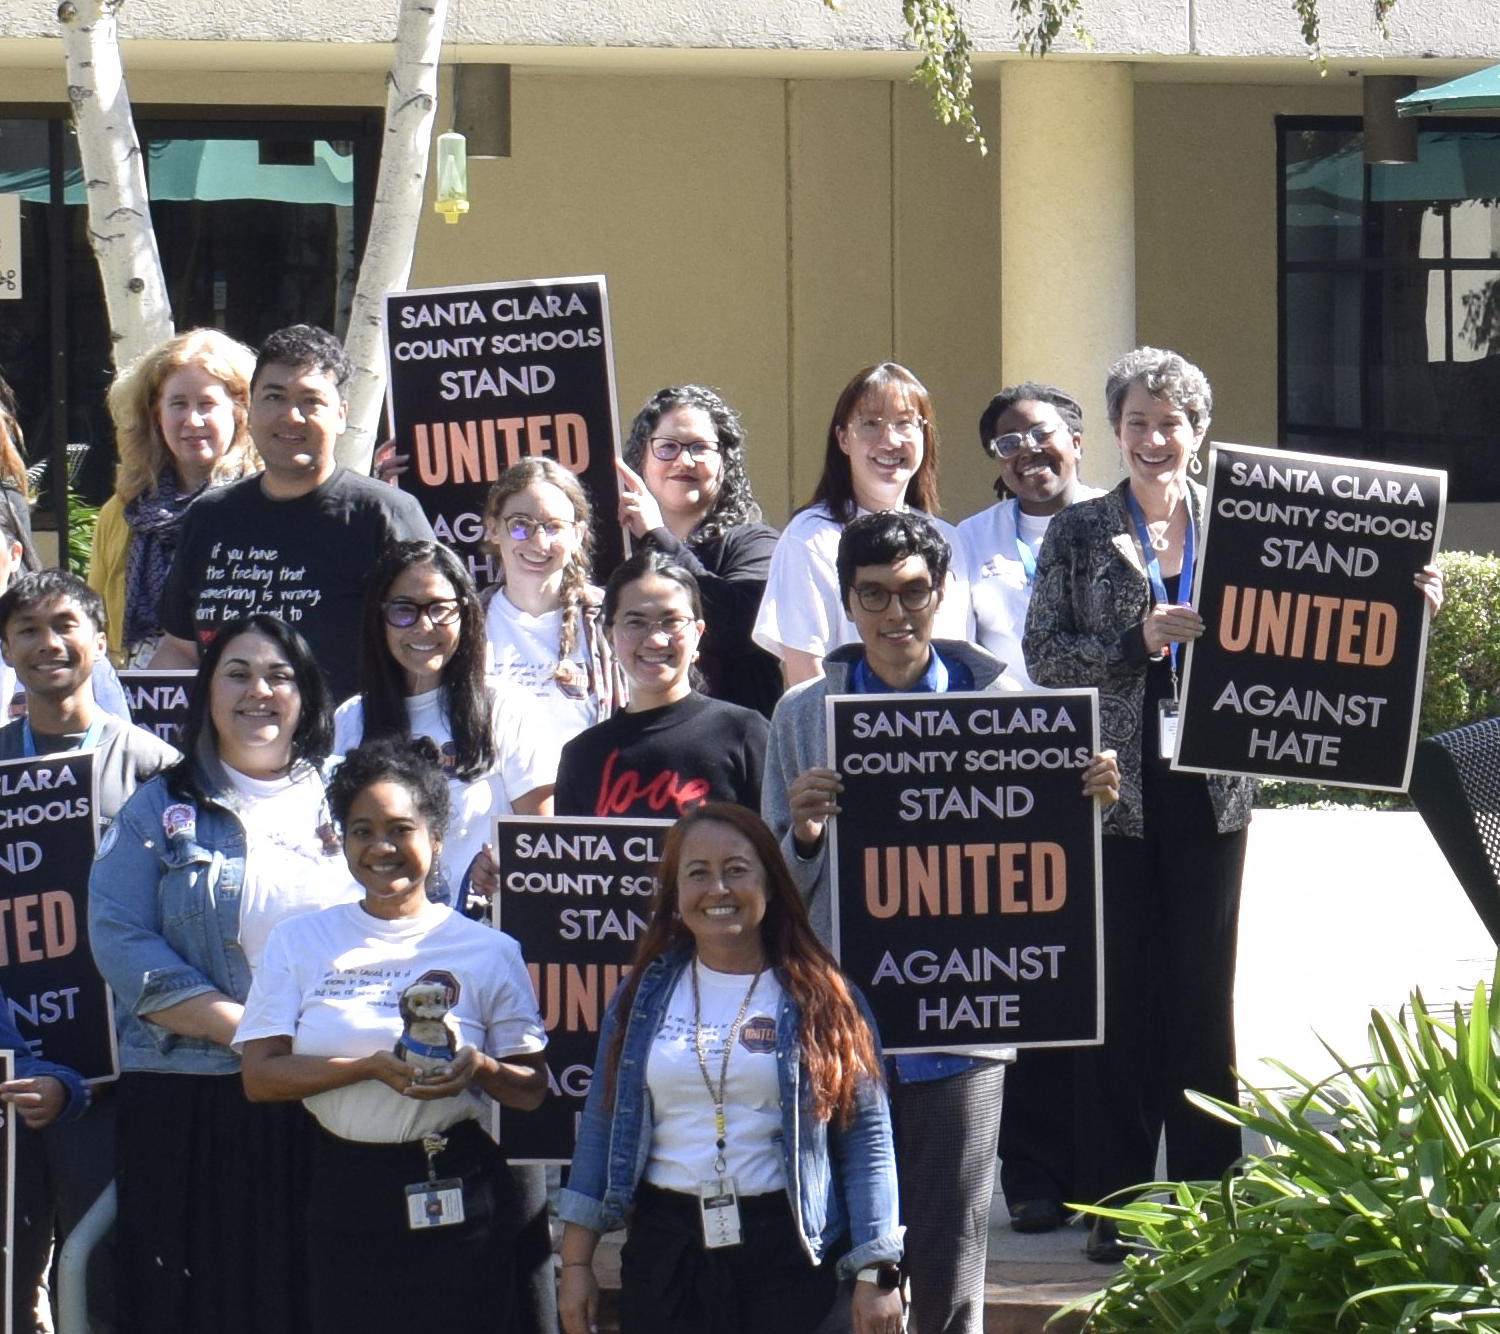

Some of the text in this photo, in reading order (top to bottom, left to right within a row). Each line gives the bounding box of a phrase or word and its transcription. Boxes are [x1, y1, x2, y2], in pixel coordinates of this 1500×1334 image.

[401, 293, 588, 329] SANTA CLARA
[395, 328, 601, 360] COUNTY SCHOOLS
[440, 365, 555, 400] STAND
[1230, 463, 1424, 507] SANTA CLARA
[1217, 499, 1433, 541] COUNTY SCHOOLS
[227, 549, 244, 565] you
[248, 546, 278, 560] have
[1260, 538, 1379, 578] STAND
[206, 564, 306, 588] the feeling that
[263, 588, 273, 601] is
[290, 605, 302, 621] to
[1219, 586, 1397, 666] UNITED
[126, 685, 189, 710] ANTA
[1213, 681, 1387, 728] AGAINST
[853, 707, 1075, 738] SANTA CLARA
[844, 747, 1089, 774] COUNTY SCHOOLS
[1249, 729, 1341, 766] HATE
[900, 786, 1034, 821] STAND
[516, 834, 616, 861] SANTA
[507, 872, 613, 896] COUNTY
[864, 842, 1066, 919] UNITED
[872, 946, 1066, 985] AGAINST
[919, 995, 1020, 1030] HATE
